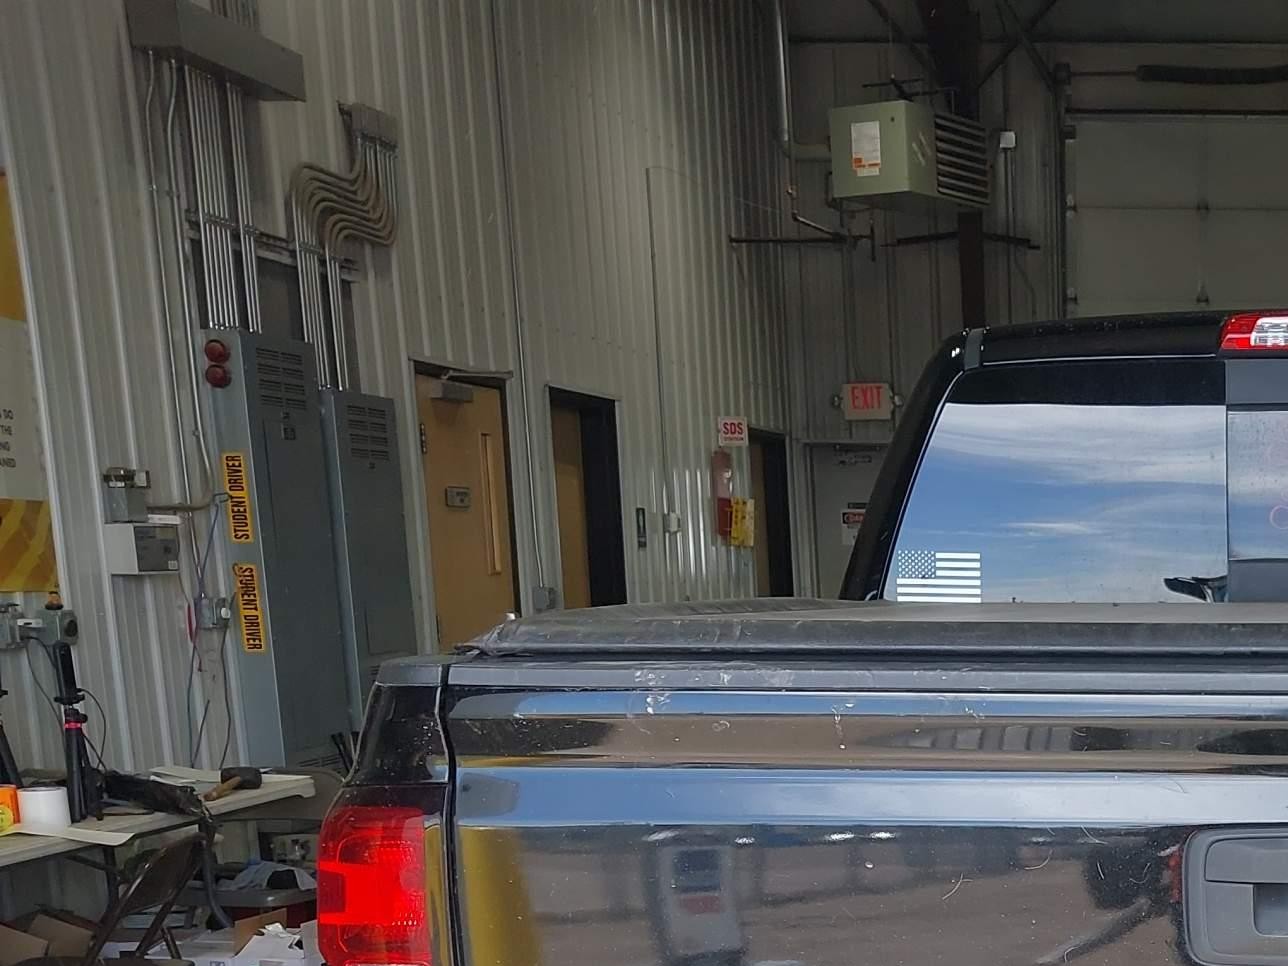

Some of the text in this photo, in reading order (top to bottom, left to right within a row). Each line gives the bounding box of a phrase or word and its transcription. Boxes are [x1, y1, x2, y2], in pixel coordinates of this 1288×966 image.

[851, 385, 883, 410] EXIT
[722, 421, 744, 435] SDS
[225, 455, 250, 540] STUDENT DRIVER
[239, 566, 263, 650] STUDENT DRIVER
